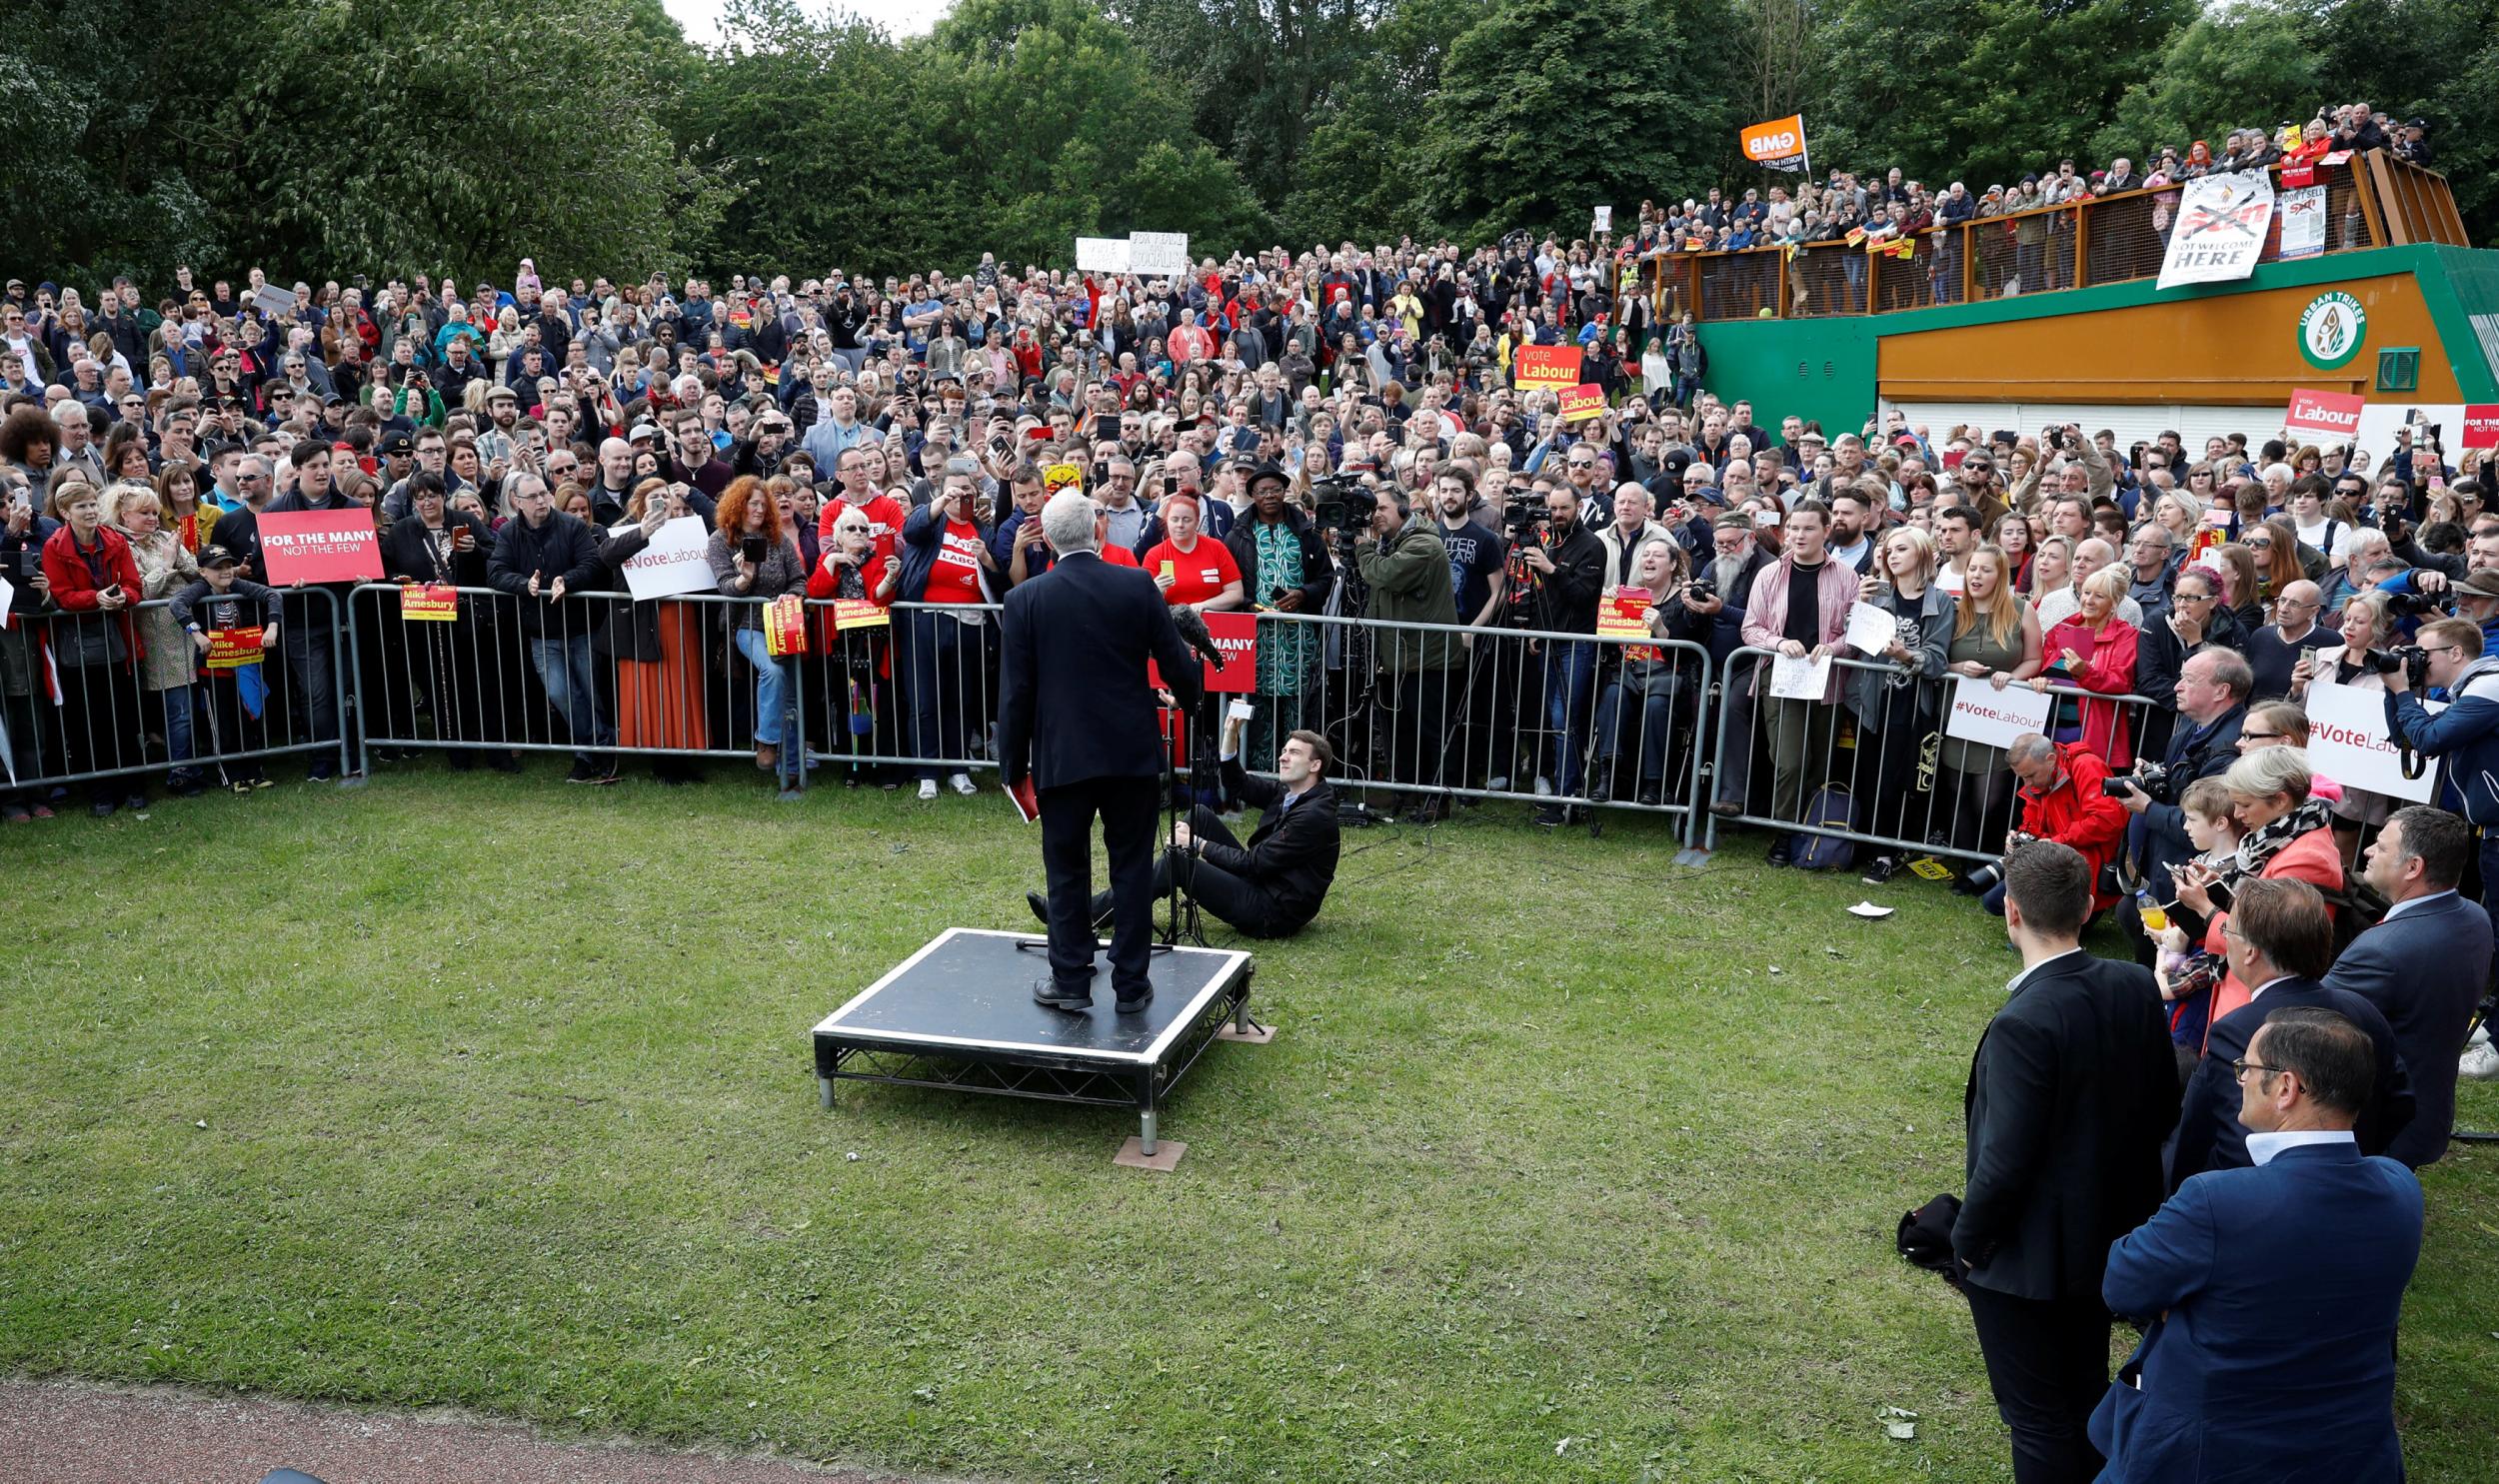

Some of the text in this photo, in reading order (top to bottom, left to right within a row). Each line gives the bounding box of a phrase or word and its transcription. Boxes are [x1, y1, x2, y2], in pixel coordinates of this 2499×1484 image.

[2306, 188, 2323, 199] SELL
[2173, 250, 2244, 269] HERE
[2299, 292, 2365, 327] URBAN TRIKES
[1524, 350, 1551, 362] vote
[1522, 363, 1576, 380] Labour
[1559, 390, 1578, 399] vote
[1560, 395, 1603, 411] Labour
[2294, 404, 2359, 426] Labour
[2465, 418, 2482, 427] FOR
[263, 530, 375, 548] FOR THE MANY
[283, 543, 361, 557] NOT THE FEW
[943, 553, 976, 566] LABO
[403, 590, 426, 600] Mike
[403, 600, 455, 612] Amesbury
[836, 601, 860, 610] Mike
[1599, 607, 1623, 617] Mike
[783, 601, 793, 625] Mike
[836, 606, 888, 619] Amesbury
[1209, 638, 1254, 651] MANY
[209, 647, 263, 658] Amesbury
[1220, 651, 1239, 662] EW
[1955, 701, 2044, 729] #VoteLabour
[2309, 721, 2432, 760] #VoteLab
